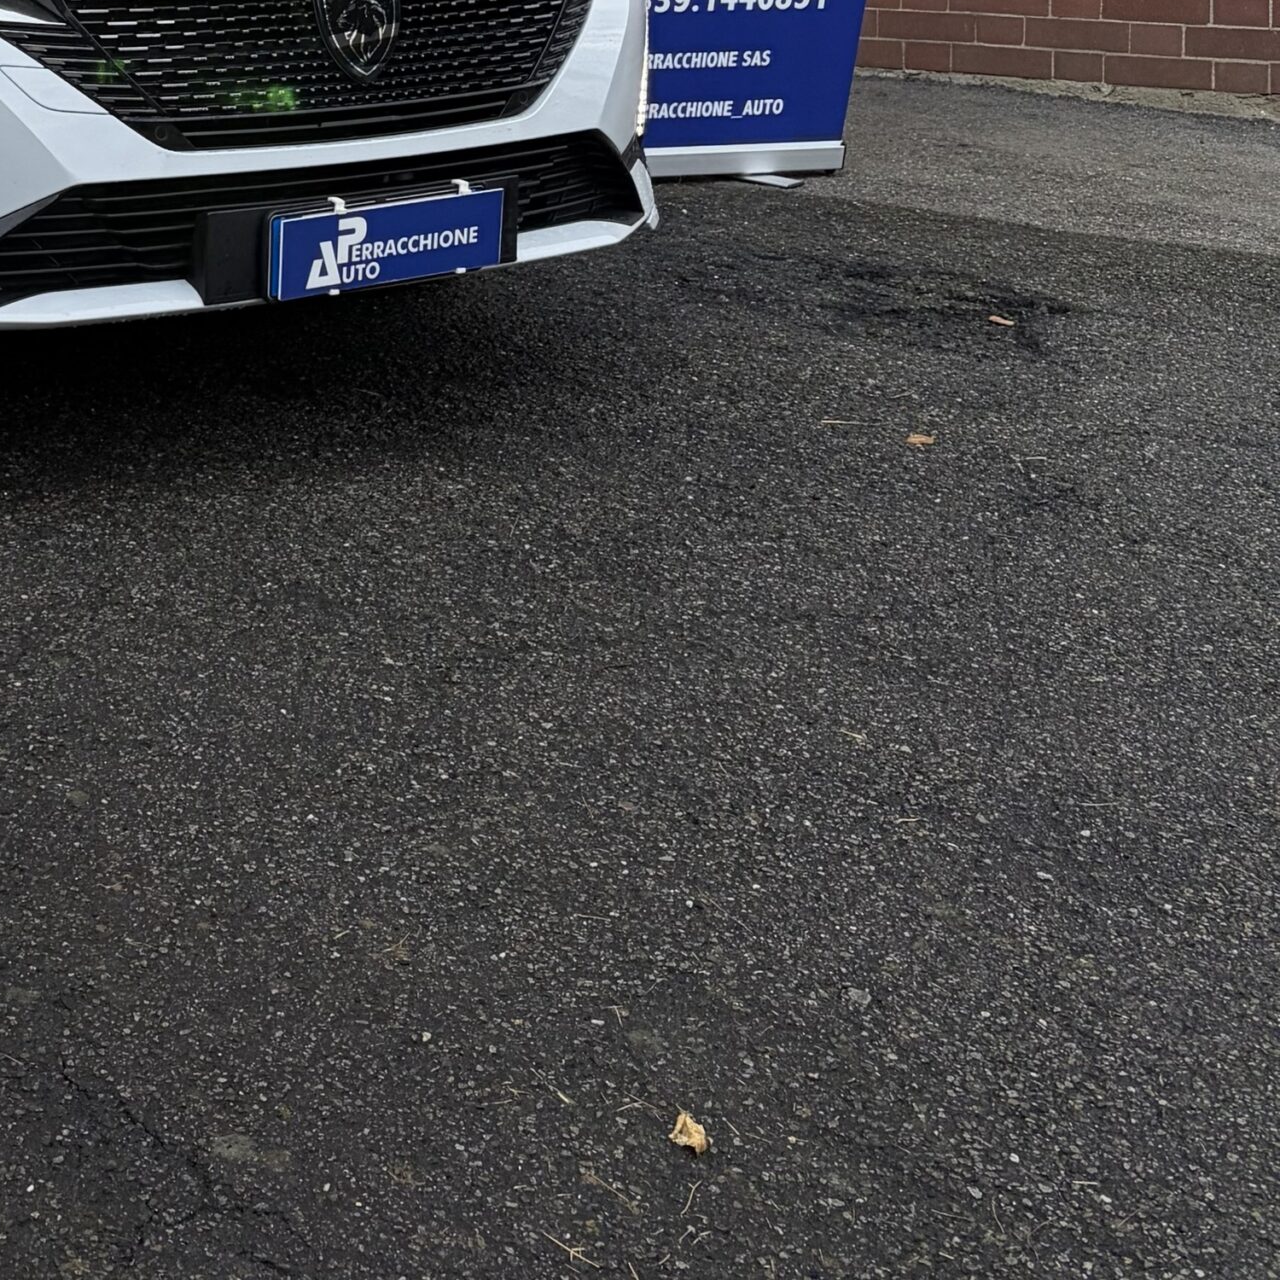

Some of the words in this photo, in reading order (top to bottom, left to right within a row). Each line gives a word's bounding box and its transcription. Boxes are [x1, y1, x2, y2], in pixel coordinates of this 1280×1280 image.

[742, 50, 771, 67] SAS
[305, 240, 381, 290] AUTO
[337, 216, 478, 265] PERRACCHIONE
